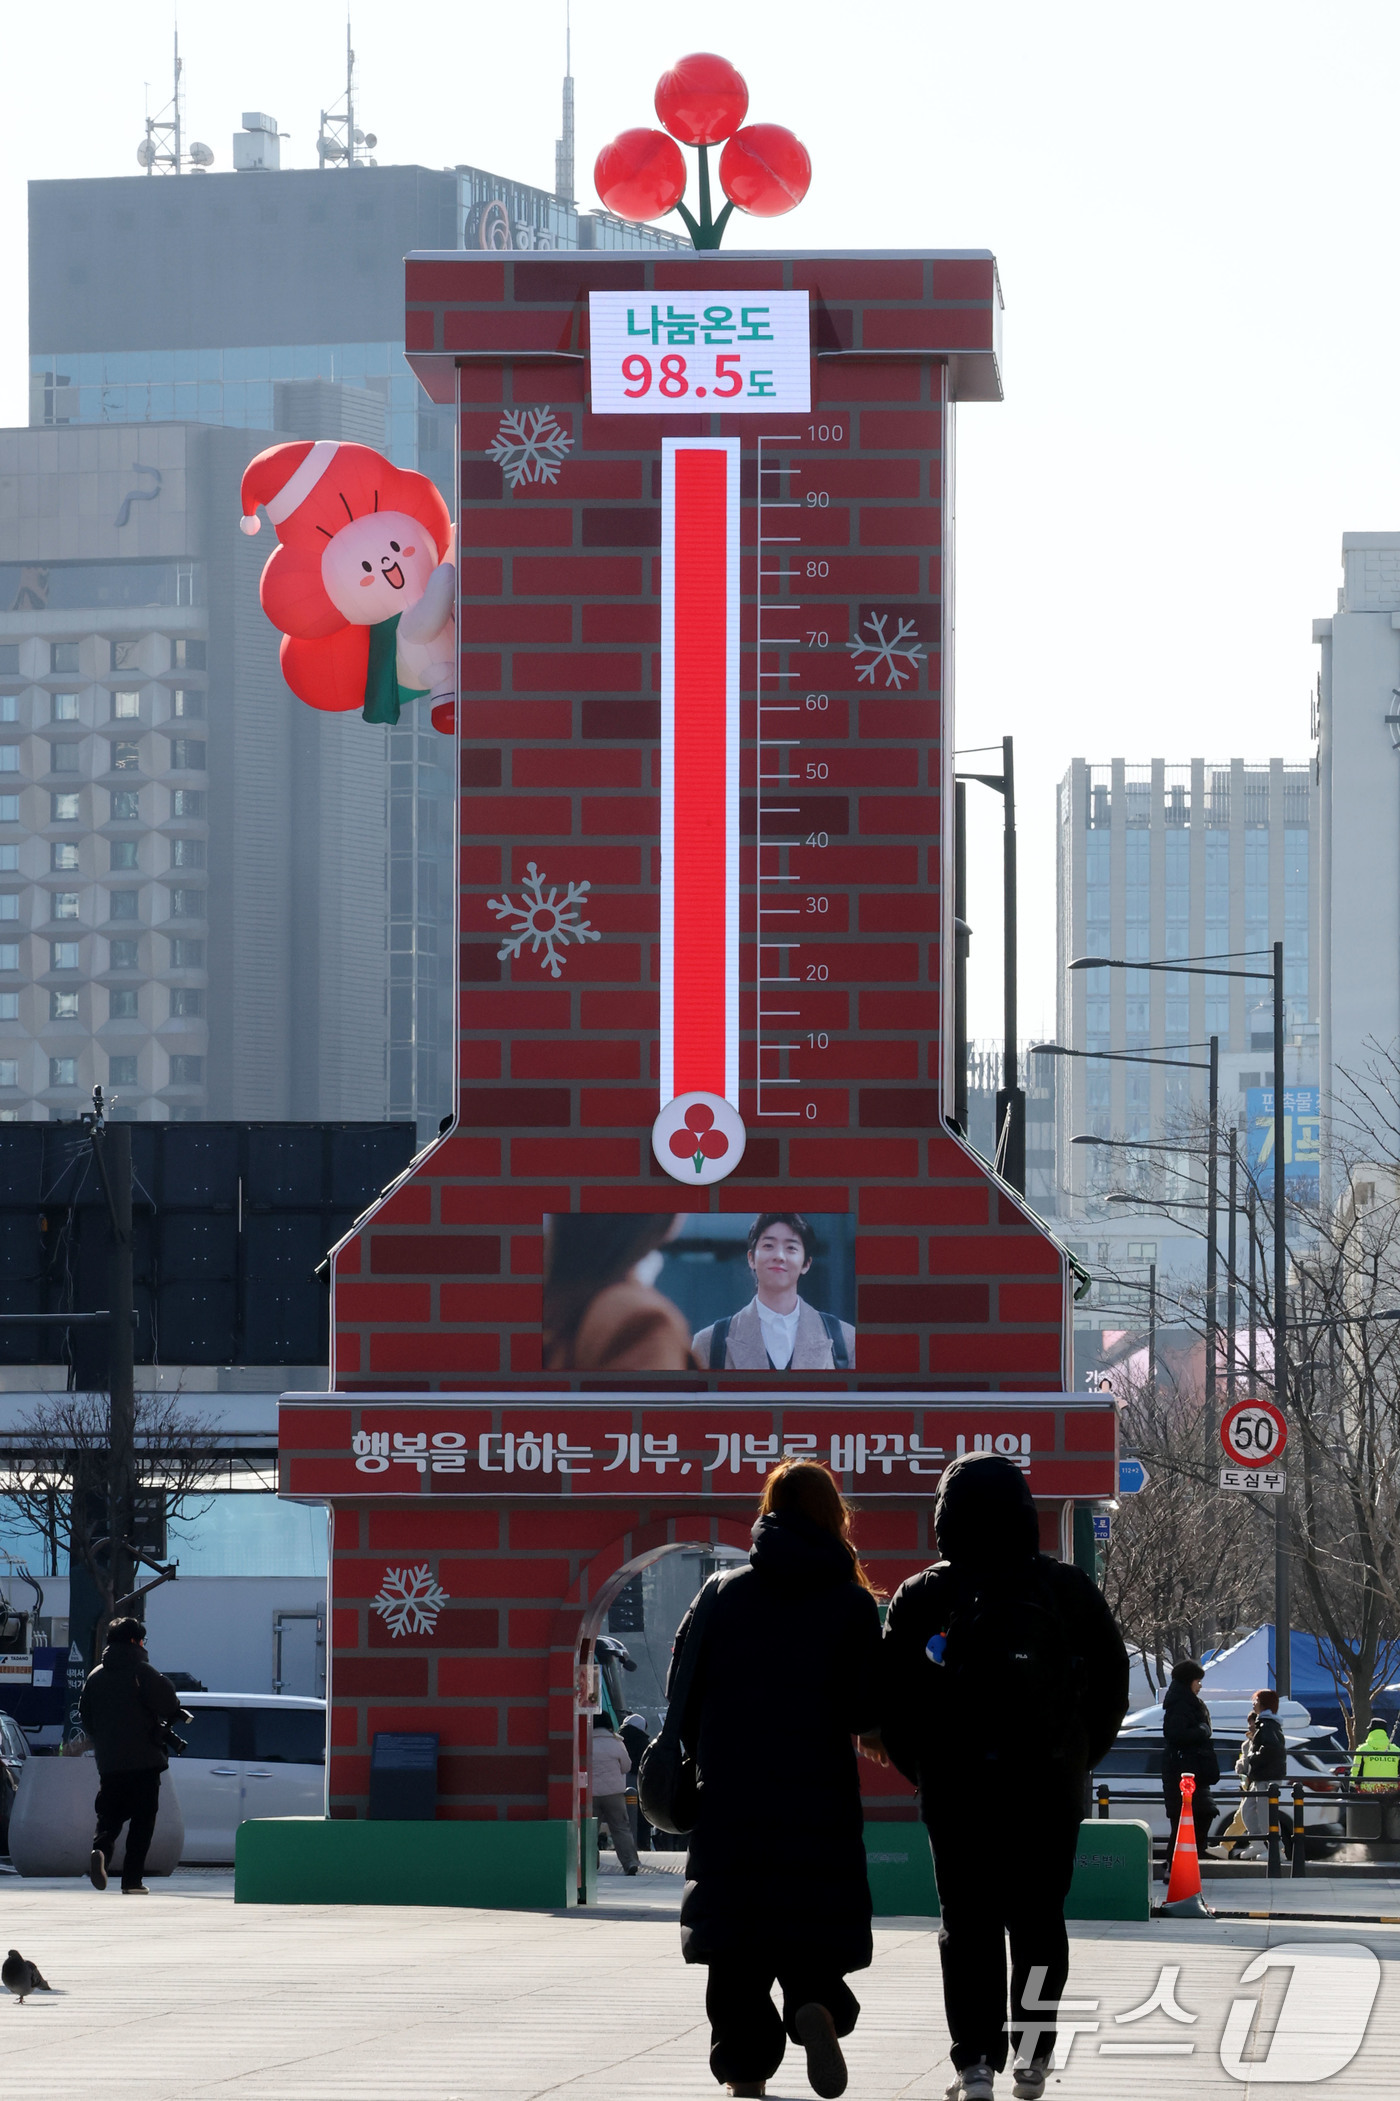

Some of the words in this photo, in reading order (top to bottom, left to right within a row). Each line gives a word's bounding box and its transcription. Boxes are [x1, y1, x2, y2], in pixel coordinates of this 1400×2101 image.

[627, 305, 774, 345] 나눔온도
[621, 354, 777, 398] 98.5도
[808, 425, 843, 442] 100
[806, 491, 830, 508] 90
[806, 561, 829, 578] 80
[806, 631, 829, 648] 70
[805, 694, 829, 711] 60
[806, 763, 829, 780] 50
[805, 831, 829, 848] 40
[806, 896, 829, 913] 30
[806, 964, 829, 981] 20
[807, 1032, 829, 1049] 10
[805, 1103, 817, 1120] 0
[1234, 1416, 1273, 1450] 50
[351, 1430, 468, 1473] 행복을
[478, 1431, 594, 1474] 더하는
[603, 1432, 692, 1475] 기부,
[703, 1433, 818, 1474] 기부로
[830, 1433, 946, 1475] 바꾸는
[1223, 1473, 1281, 1490] 도심부
